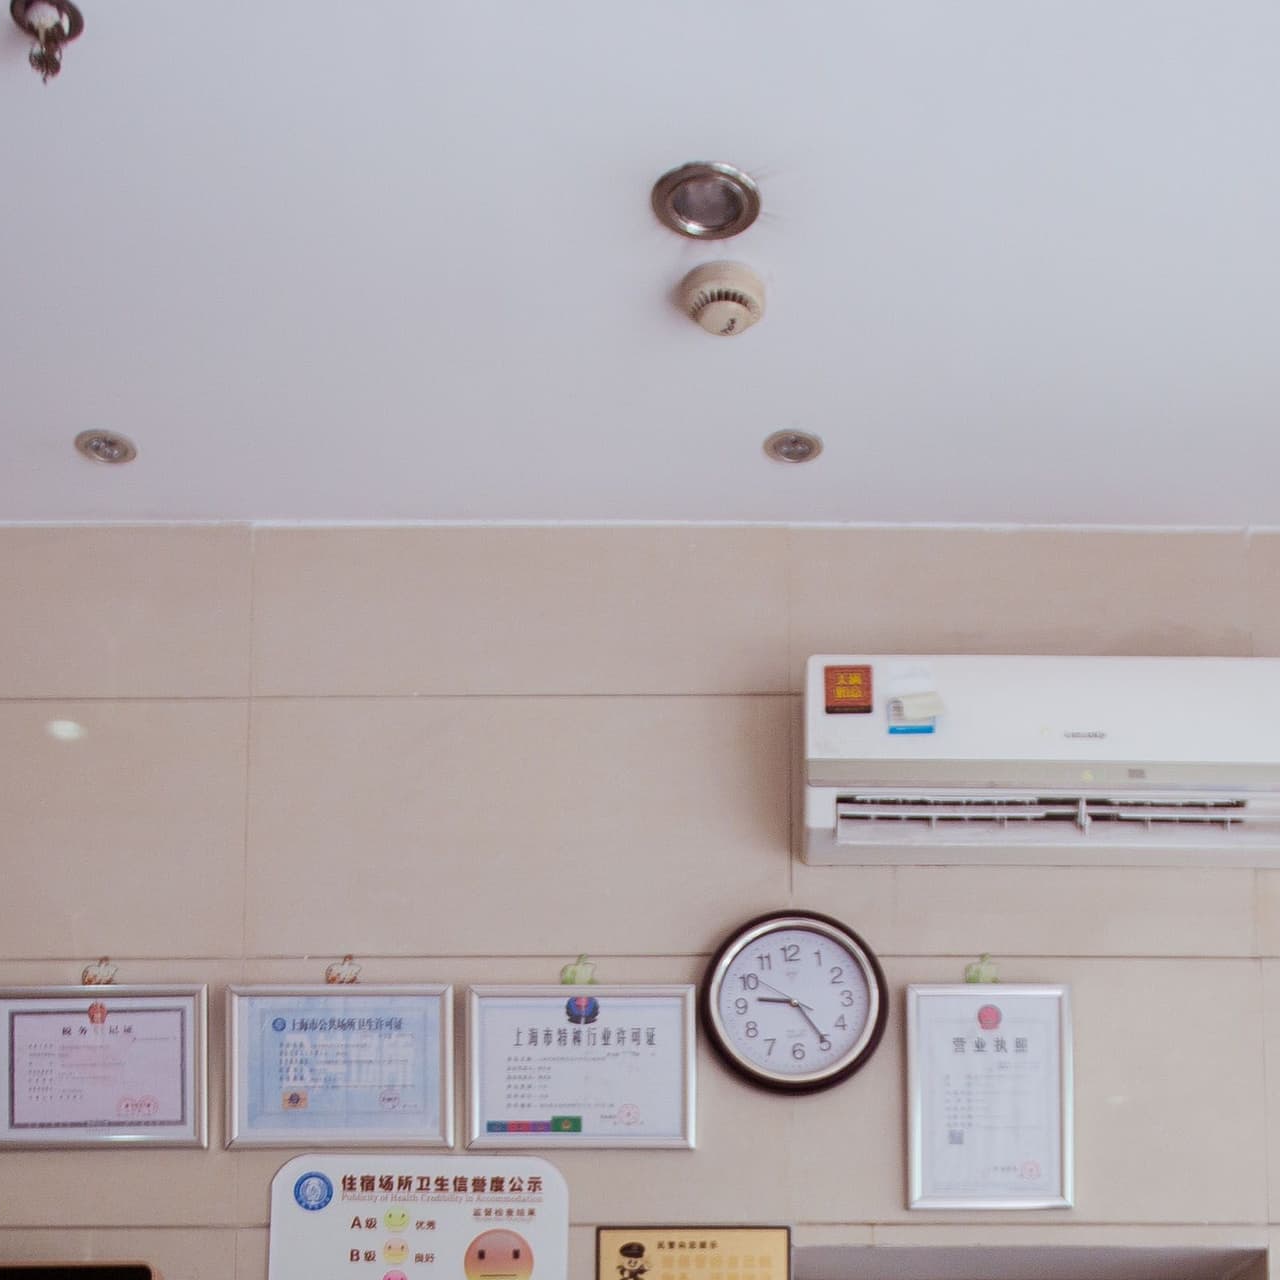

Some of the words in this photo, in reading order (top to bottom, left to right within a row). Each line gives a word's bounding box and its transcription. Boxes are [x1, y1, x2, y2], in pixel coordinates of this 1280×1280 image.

[757, 953, 772, 970] 11
[780, 944, 800, 962] 12
[814, 950, 822, 967] 1
[739, 973, 759, 990] 10
[830, 966, 844, 984] 2
[735, 997, 748, 1015] 9
[840, 990, 854, 1007] 3
[745, 1021, 758, 1038] 8
[834, 1014, 848, 1030] 4
[764, 1038, 776, 1056] 7
[820, 1033, 832, 1051] 5
[952, 1037, 1029, 1054] 营业执照
[792, 1043, 806, 1060] 6
[341, 1174, 544, 1193] 住宿场所卫生信誉度公示
[415, 1219, 436, 1230] 优秀
[414, 1253, 435, 1263] 良好
